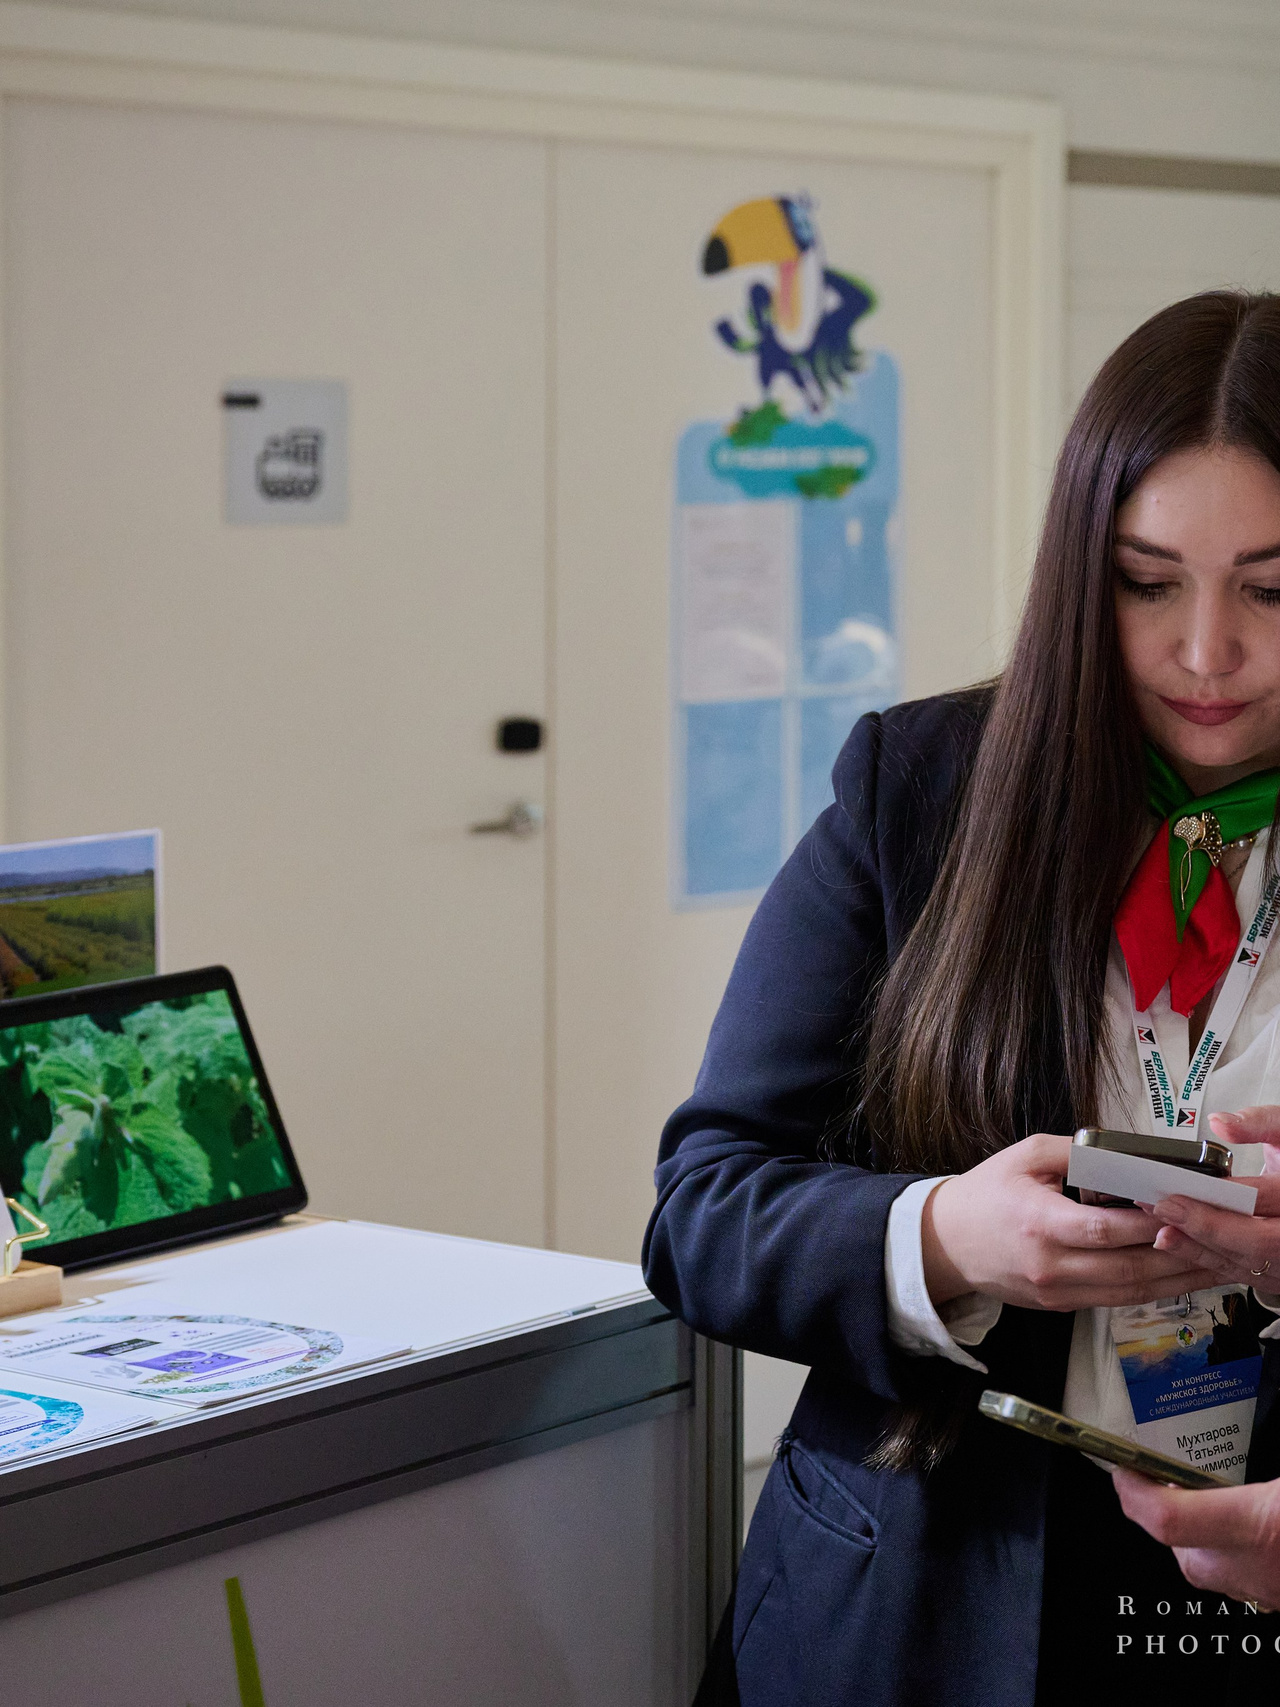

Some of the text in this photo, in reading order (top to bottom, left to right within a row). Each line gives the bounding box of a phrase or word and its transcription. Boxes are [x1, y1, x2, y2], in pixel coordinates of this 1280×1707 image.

[1182, 1030, 1216, 1101] БЕРЛИН-ХЕМИ
[1193, 1041, 1222, 1092] МЕНАРИНИ
[1143, 1059, 1164, 1119] МЕНАРИНИ
[1151, 1050, 1175, 1127] БЕРЛИН-ХЕМИ
[1155, 1378, 1243, 1403] «МУЖСКОЕ ЗДОРОВЬЕ»
[1171, 1371, 1223, 1389] XXI КОНГРЕСС
[1149, 1386, 1256, 1417] С МЕЖДУНАРОДНЫМ УЧАСТИЕМ
[1176, 1423, 1240, 1449] Мухтарова
[1186, 1441, 1235, 1461] Татьяна
